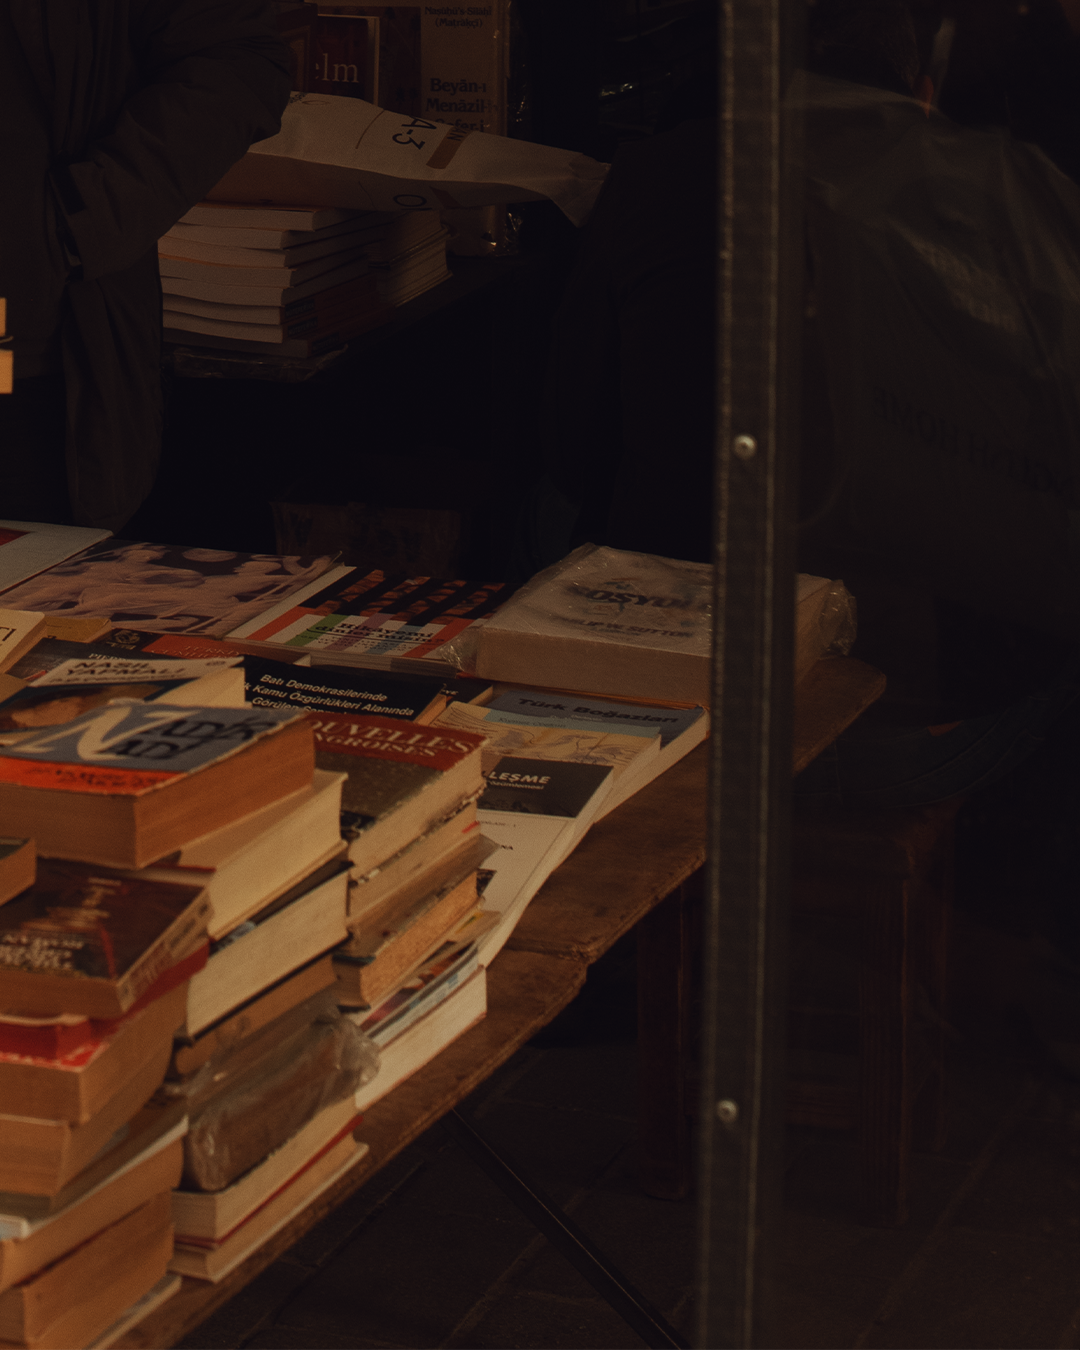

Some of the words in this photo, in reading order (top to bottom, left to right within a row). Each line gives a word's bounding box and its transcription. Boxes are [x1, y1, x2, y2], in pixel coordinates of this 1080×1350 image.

[252, 684, 287, 698] Kamu
[289, 689, 360, 711] Özgürlükleri
[362, 703, 415, 717] Alanında
[260, 673, 284, 686] Batı
[285, 679, 388, 702] Demokrasilerinde
[518, 697, 566, 712] Türk
[572, 702, 678, 723] Boğazları
